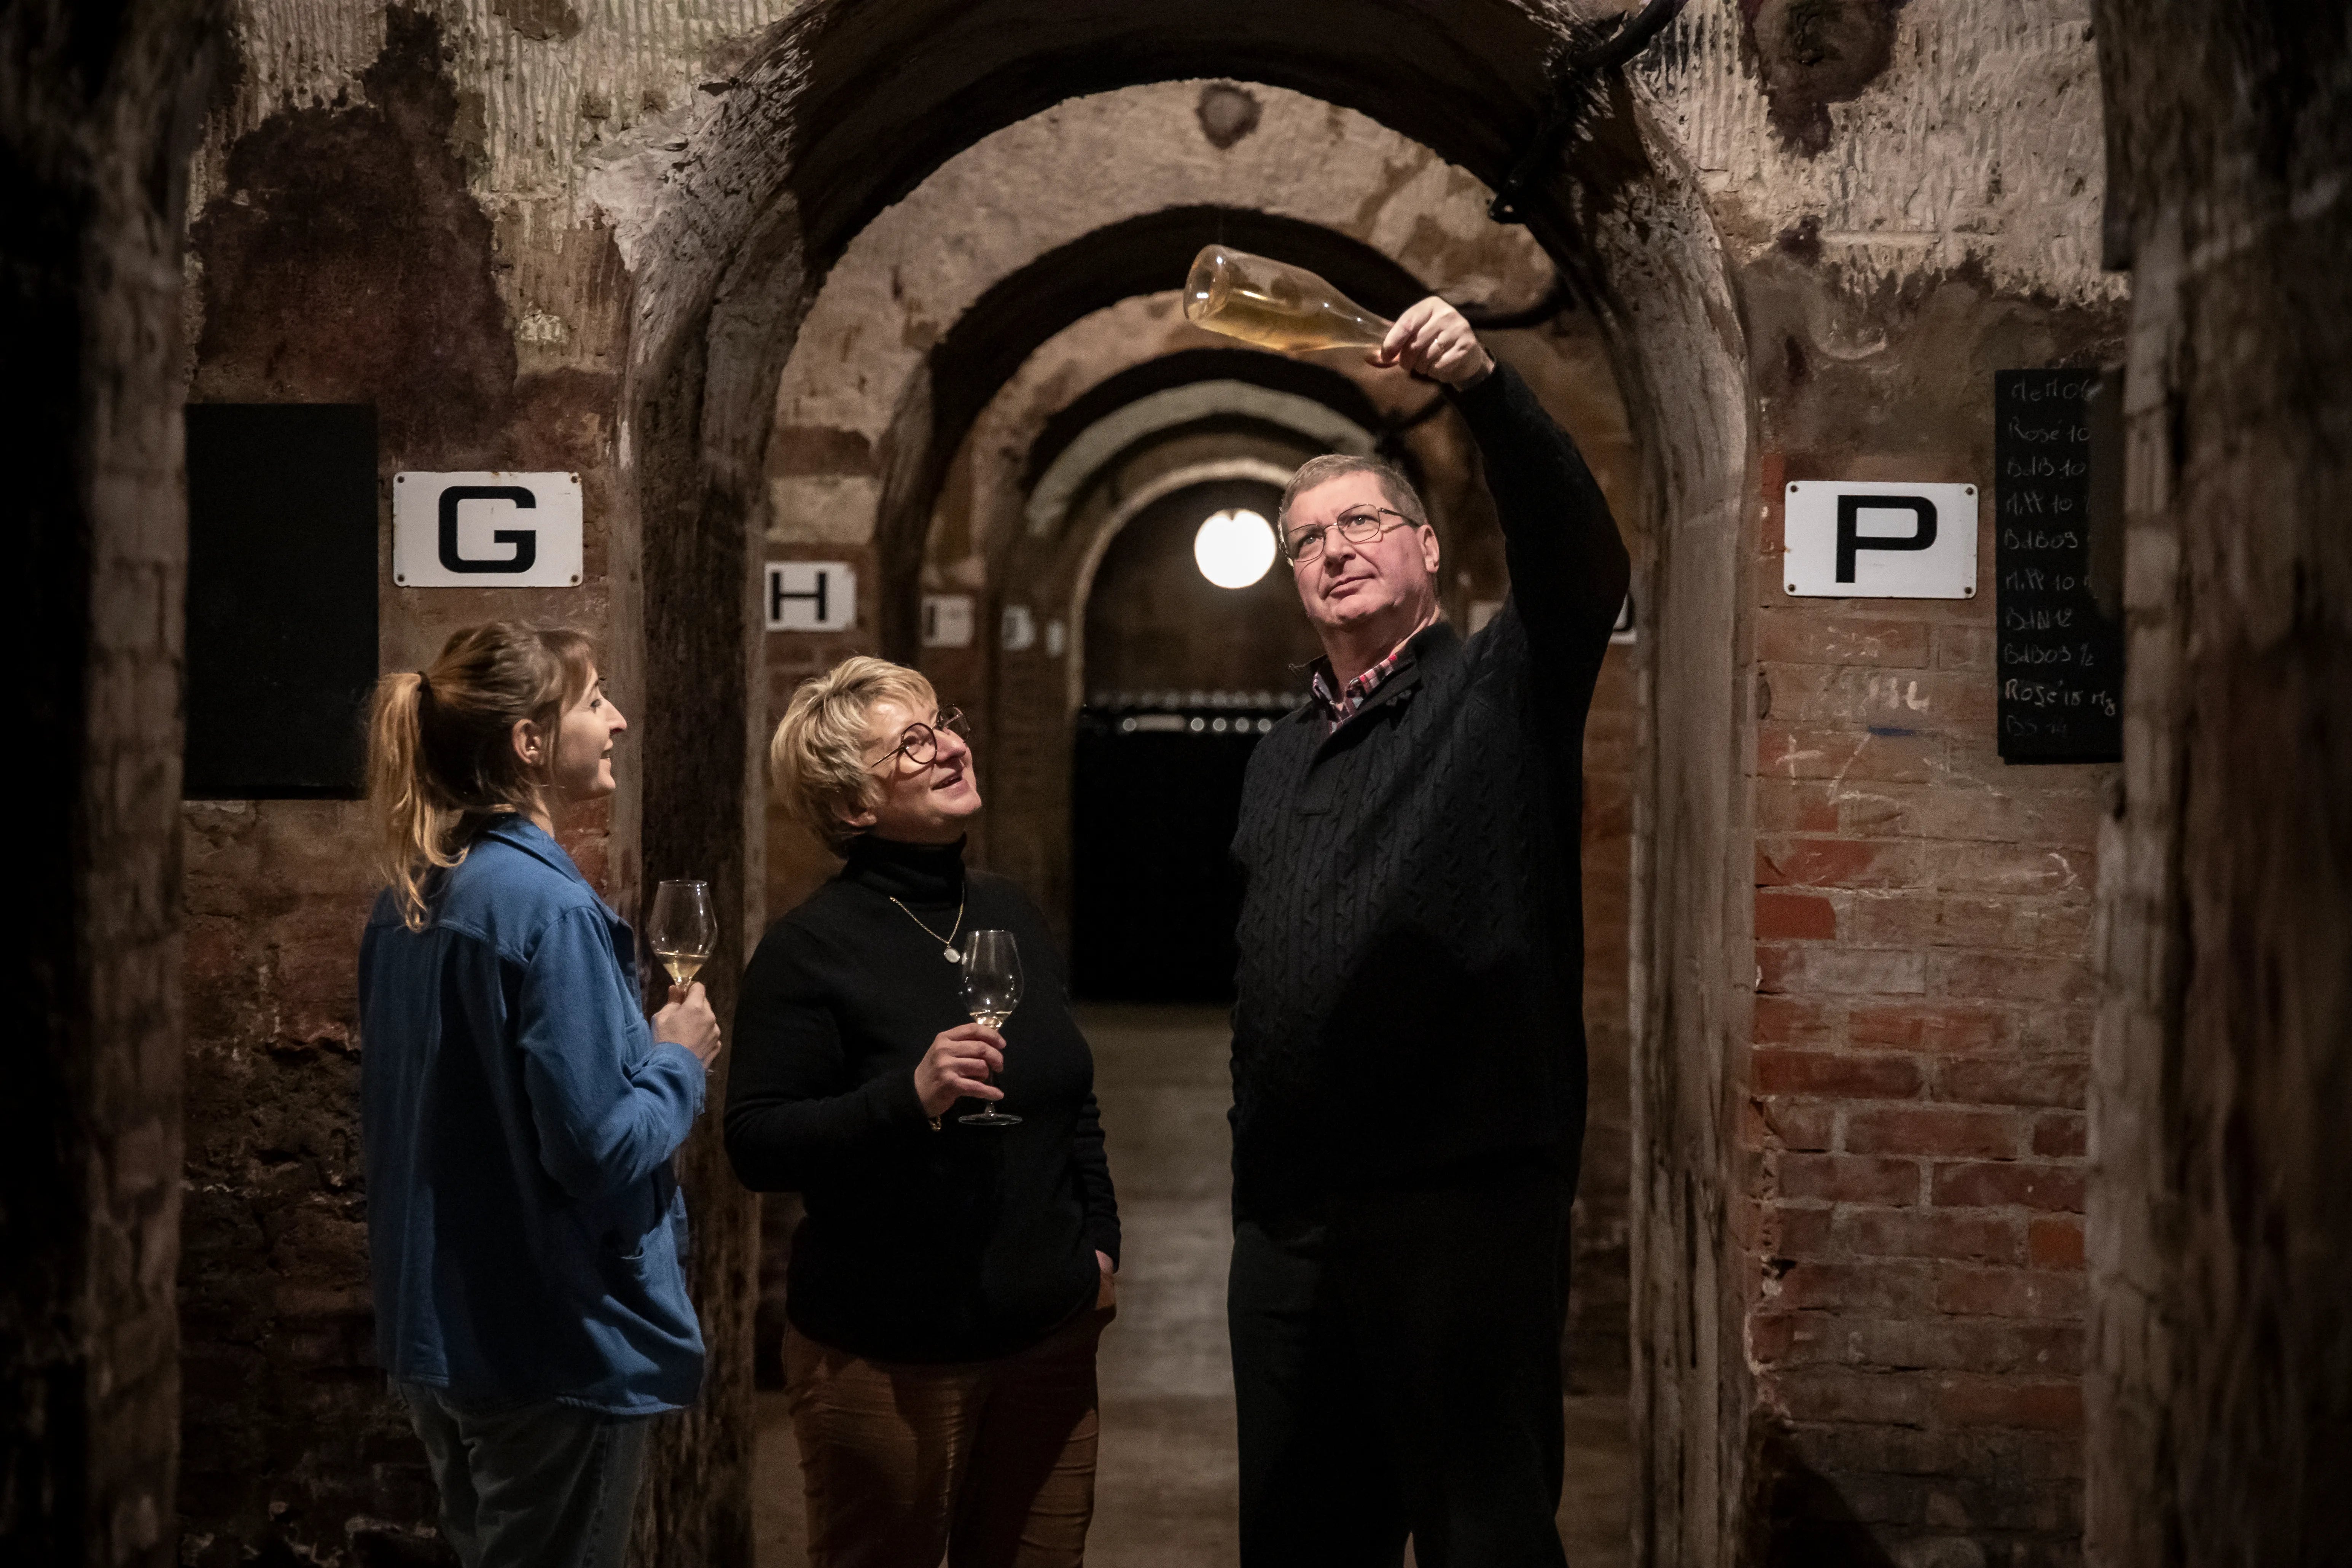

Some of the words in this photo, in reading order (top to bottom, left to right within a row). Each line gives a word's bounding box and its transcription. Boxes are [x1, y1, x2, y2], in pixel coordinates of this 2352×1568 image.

[439, 486, 536, 573] G
[1836, 495, 1937, 583] P
[772, 572, 826, 620] H
